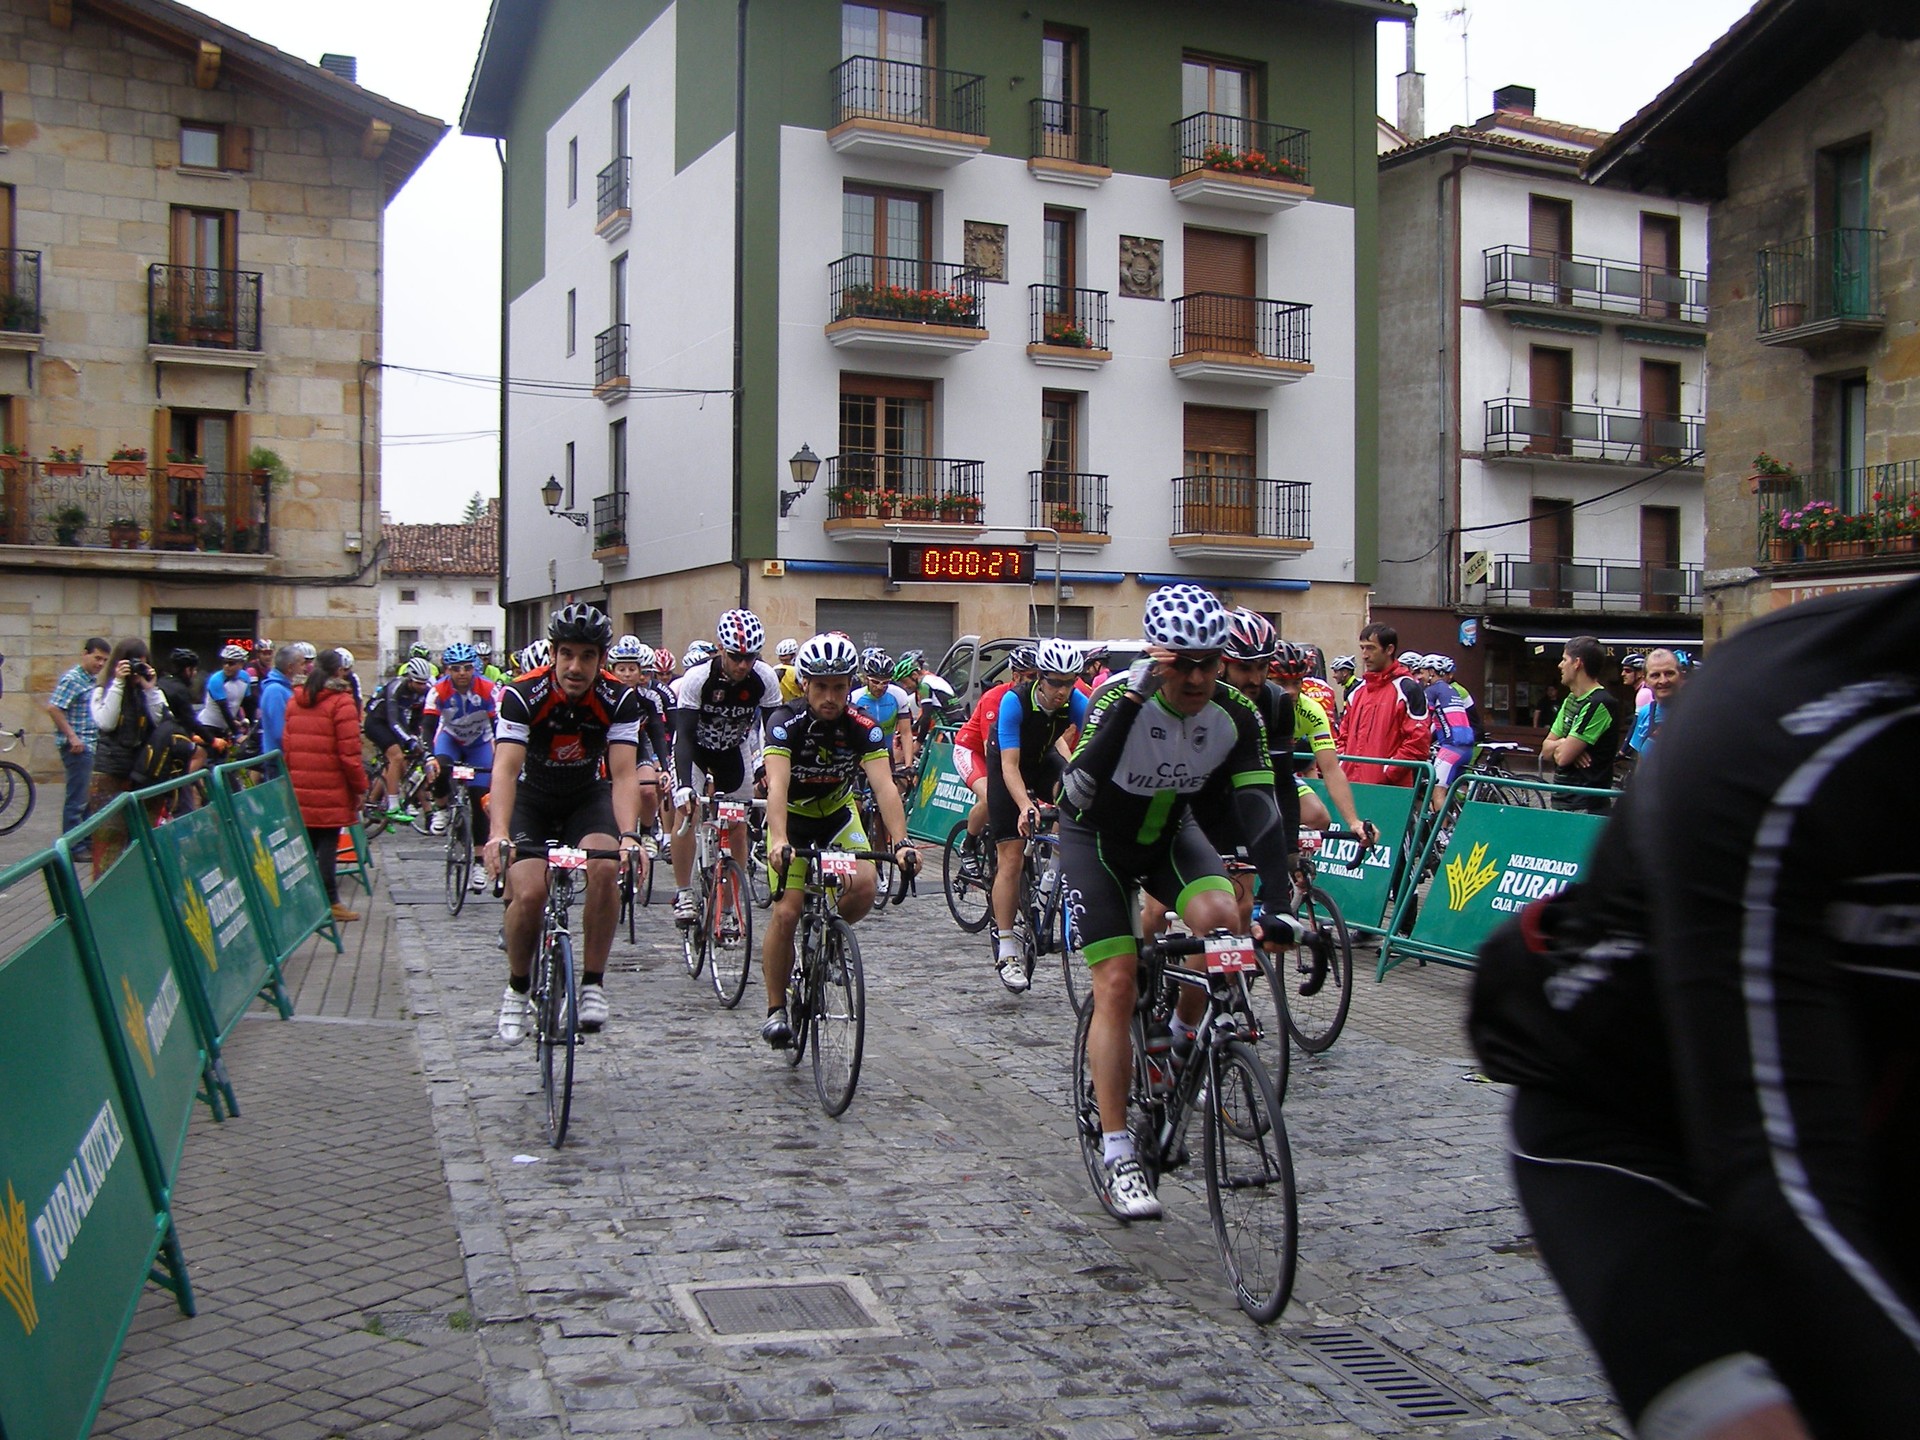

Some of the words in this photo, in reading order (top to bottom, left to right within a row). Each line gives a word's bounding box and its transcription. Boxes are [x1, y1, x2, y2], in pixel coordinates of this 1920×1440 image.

[924, 551, 1020, 576] 0:00:27
[1466, 555, 1485, 576] KELER
[726, 809, 737, 817] 41
[1301, 839, 1315, 848] 28
[559, 856, 576, 865] 71
[828, 860, 851, 871] 103
[1507, 853, 1579, 877] NAFARROAKO
[1491, 896, 1513, 911] CAJA
[1220, 951, 1242, 966] 92
